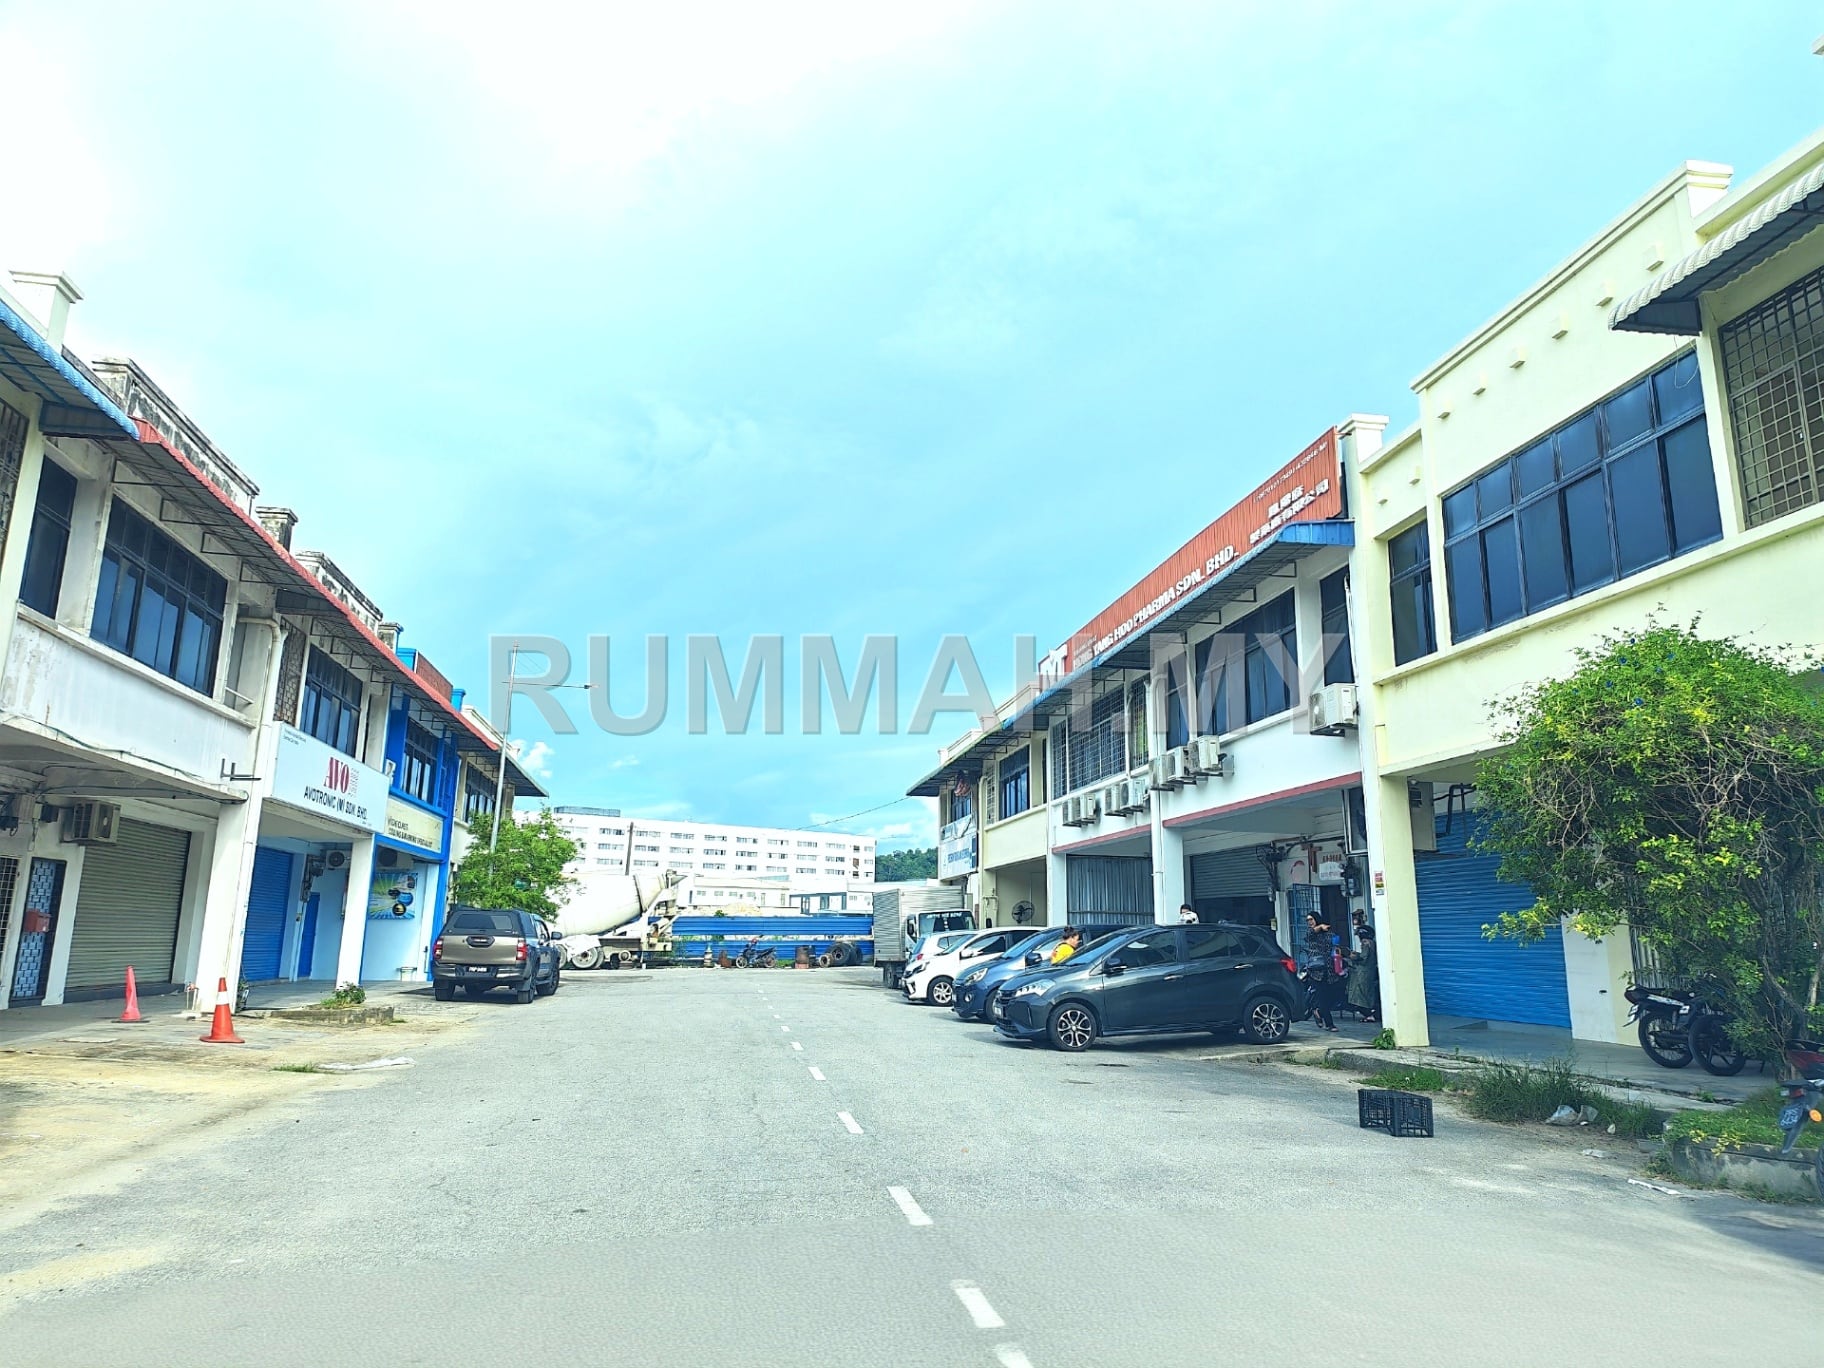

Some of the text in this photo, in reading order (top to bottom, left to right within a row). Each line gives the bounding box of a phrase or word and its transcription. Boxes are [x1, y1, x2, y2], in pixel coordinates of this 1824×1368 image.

[1114, 619, 1133, 641] HOO
[1133, 586, 1176, 627] PHARMA
[1176, 568, 1206, 596] SDN.
[1206, 545, 1240, 576] BHD.
[324, 756, 350, 793] AVO
